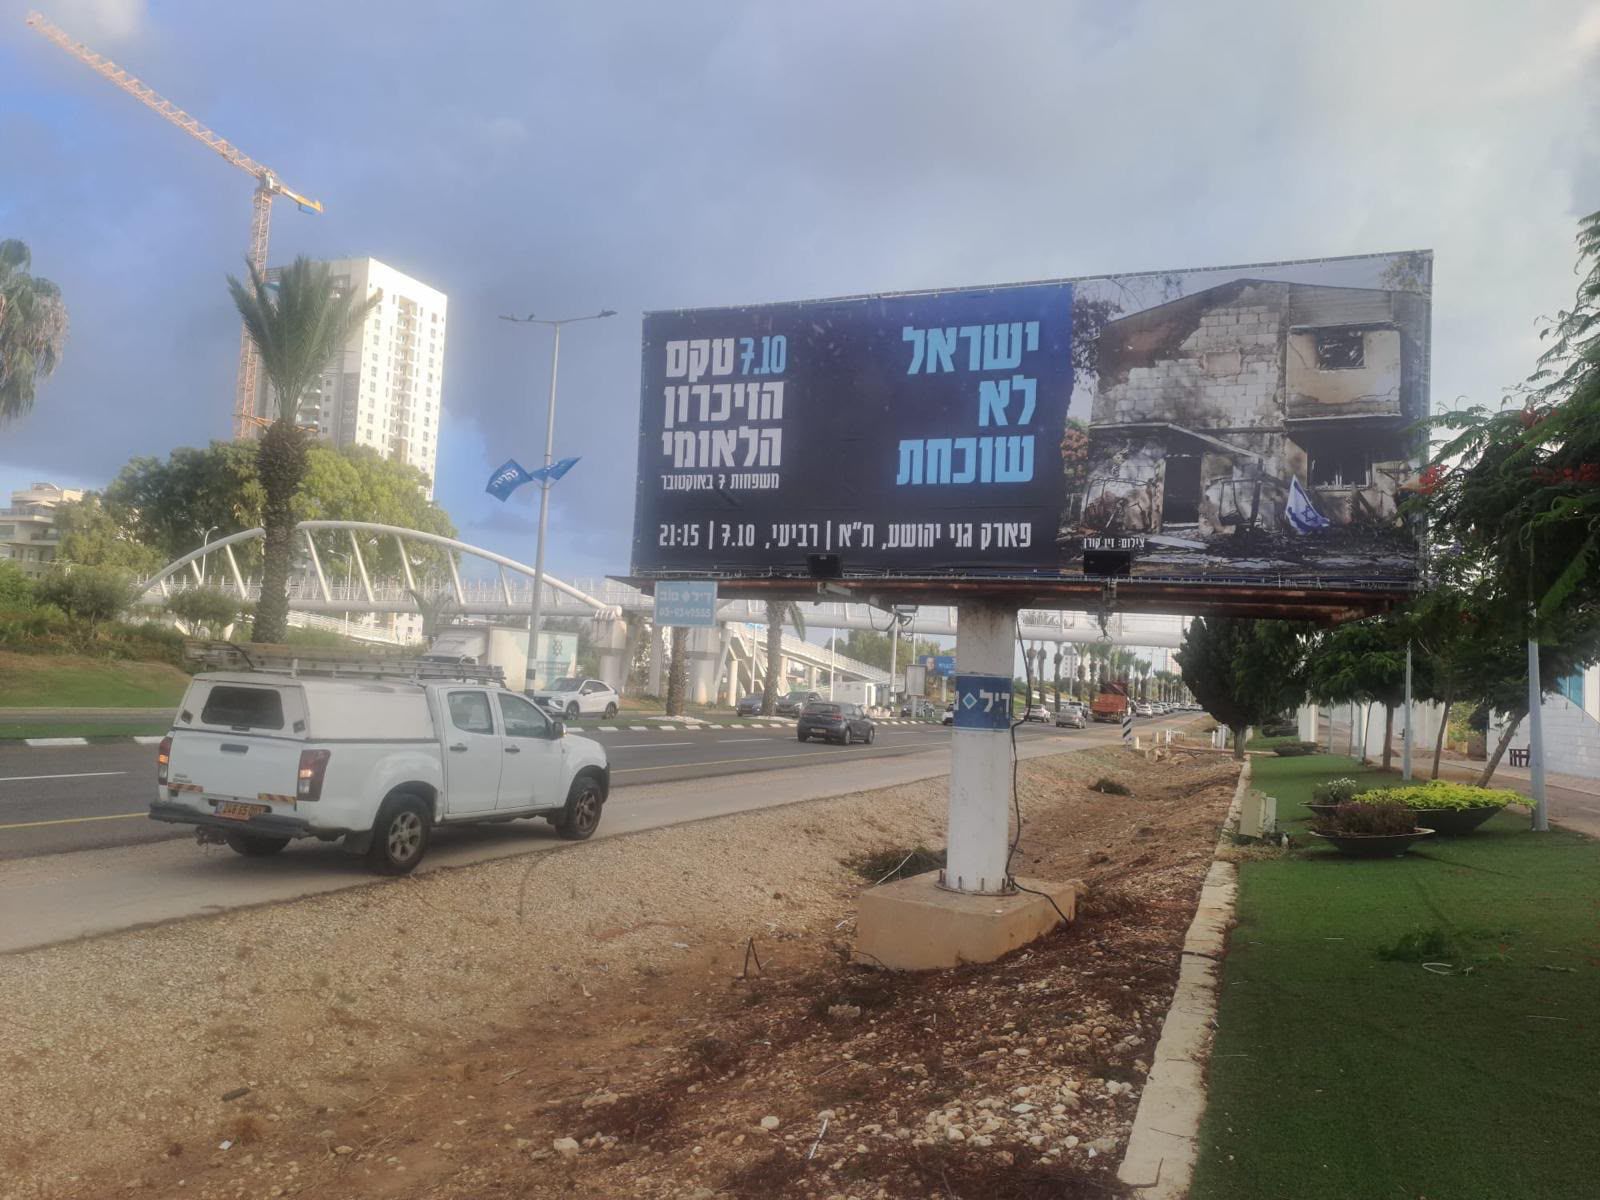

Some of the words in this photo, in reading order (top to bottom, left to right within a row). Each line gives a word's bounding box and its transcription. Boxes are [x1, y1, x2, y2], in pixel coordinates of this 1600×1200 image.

[665, 337, 735, 382] טקס
[739, 334, 787, 375] 7.10
[902, 320, 1040, 375] ישראל
[663, 381, 784, 429] הזיכרון
[978, 374, 1037, 427] לא
[661, 425, 782, 468] הלאומי
[896, 434, 1035, 486] שוכחת
[660, 474, 714, 491] באוקטובר
[718, 474, 726, 489] 7
[729, 472, 780, 489] משפחות
[659, 523, 700, 547] 21:15
[721, 523, 755, 547] 7.10
[765, 523, 818, 549] רביעי,
[881, 522, 942, 550] יהושע,
[949, 522, 973, 548] גני
[980, 522, 1032, 550] פארק
[1083, 537, 1101, 550] קורן
[1117, 537, 1146, 549] צילום:
[979, 688, 1011, 720] דיל
